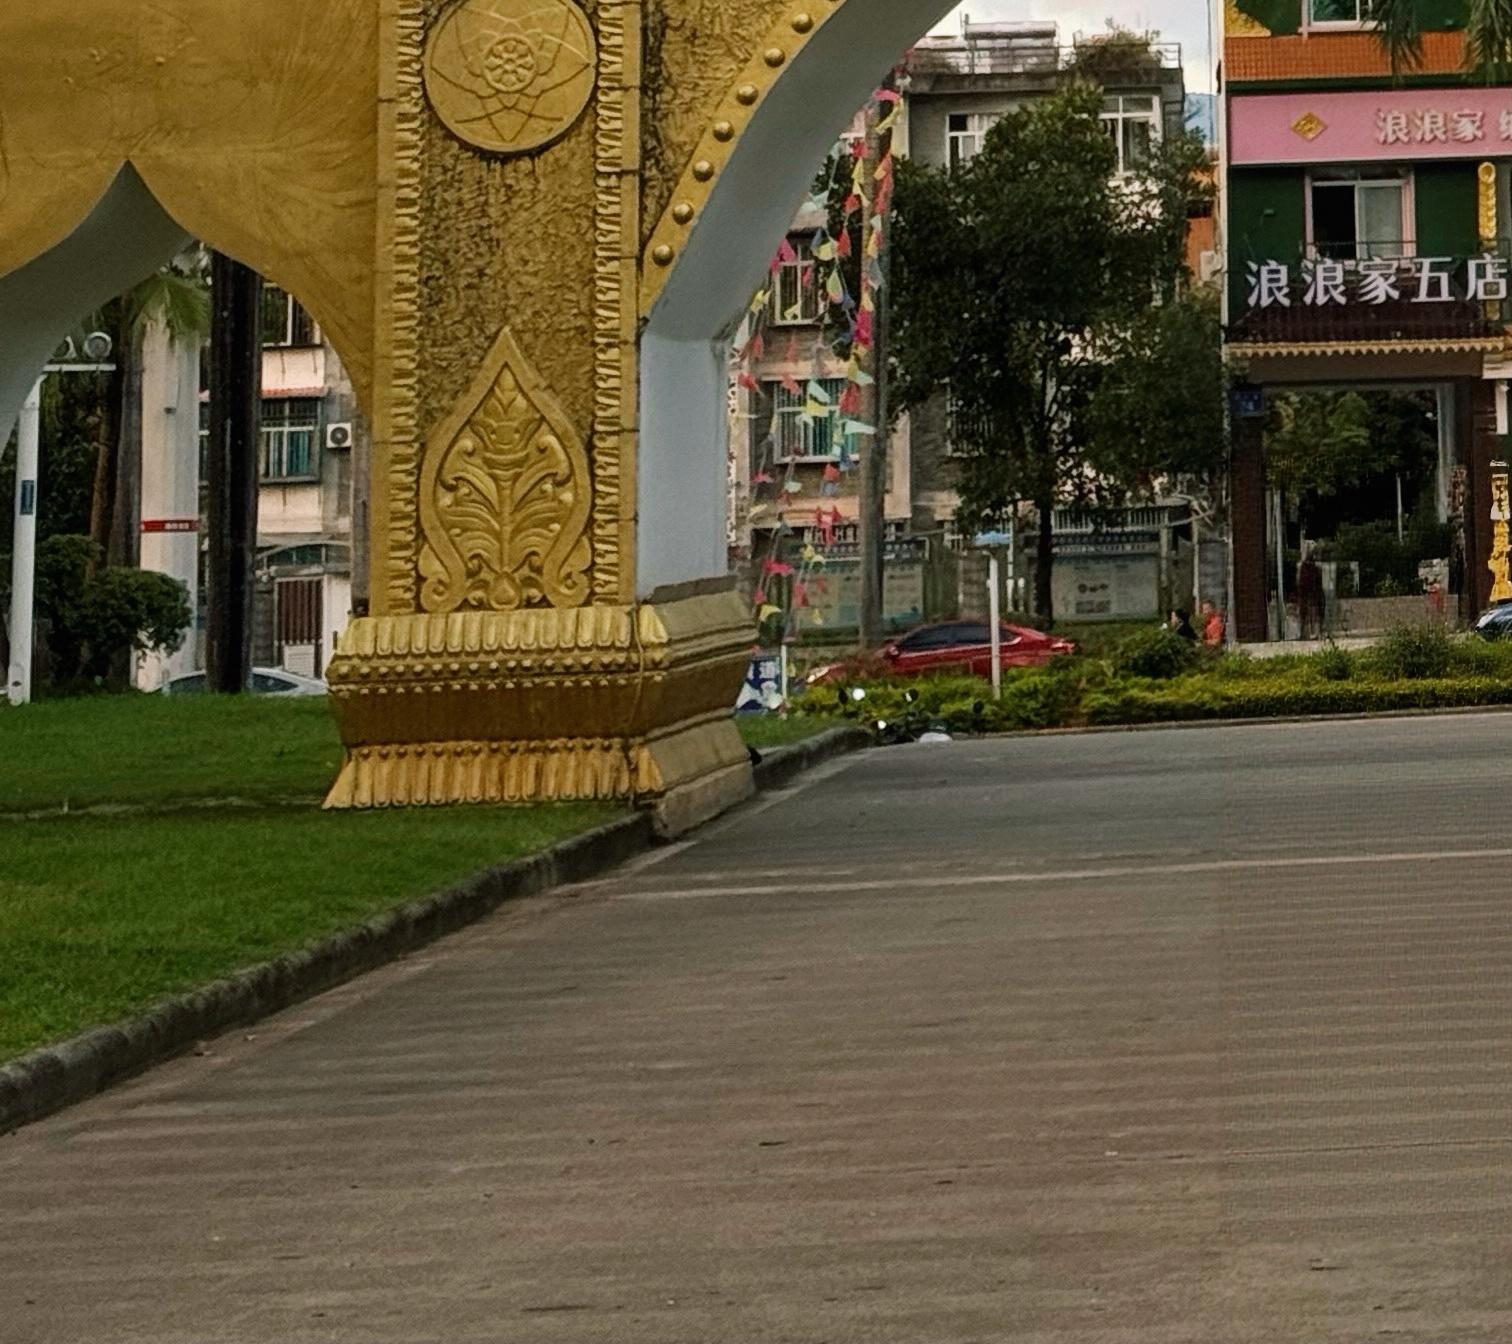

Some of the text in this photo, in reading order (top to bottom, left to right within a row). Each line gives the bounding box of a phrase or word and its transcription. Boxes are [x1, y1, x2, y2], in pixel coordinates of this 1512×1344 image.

[1246, 252, 1508, 308] 浪浪家五店
